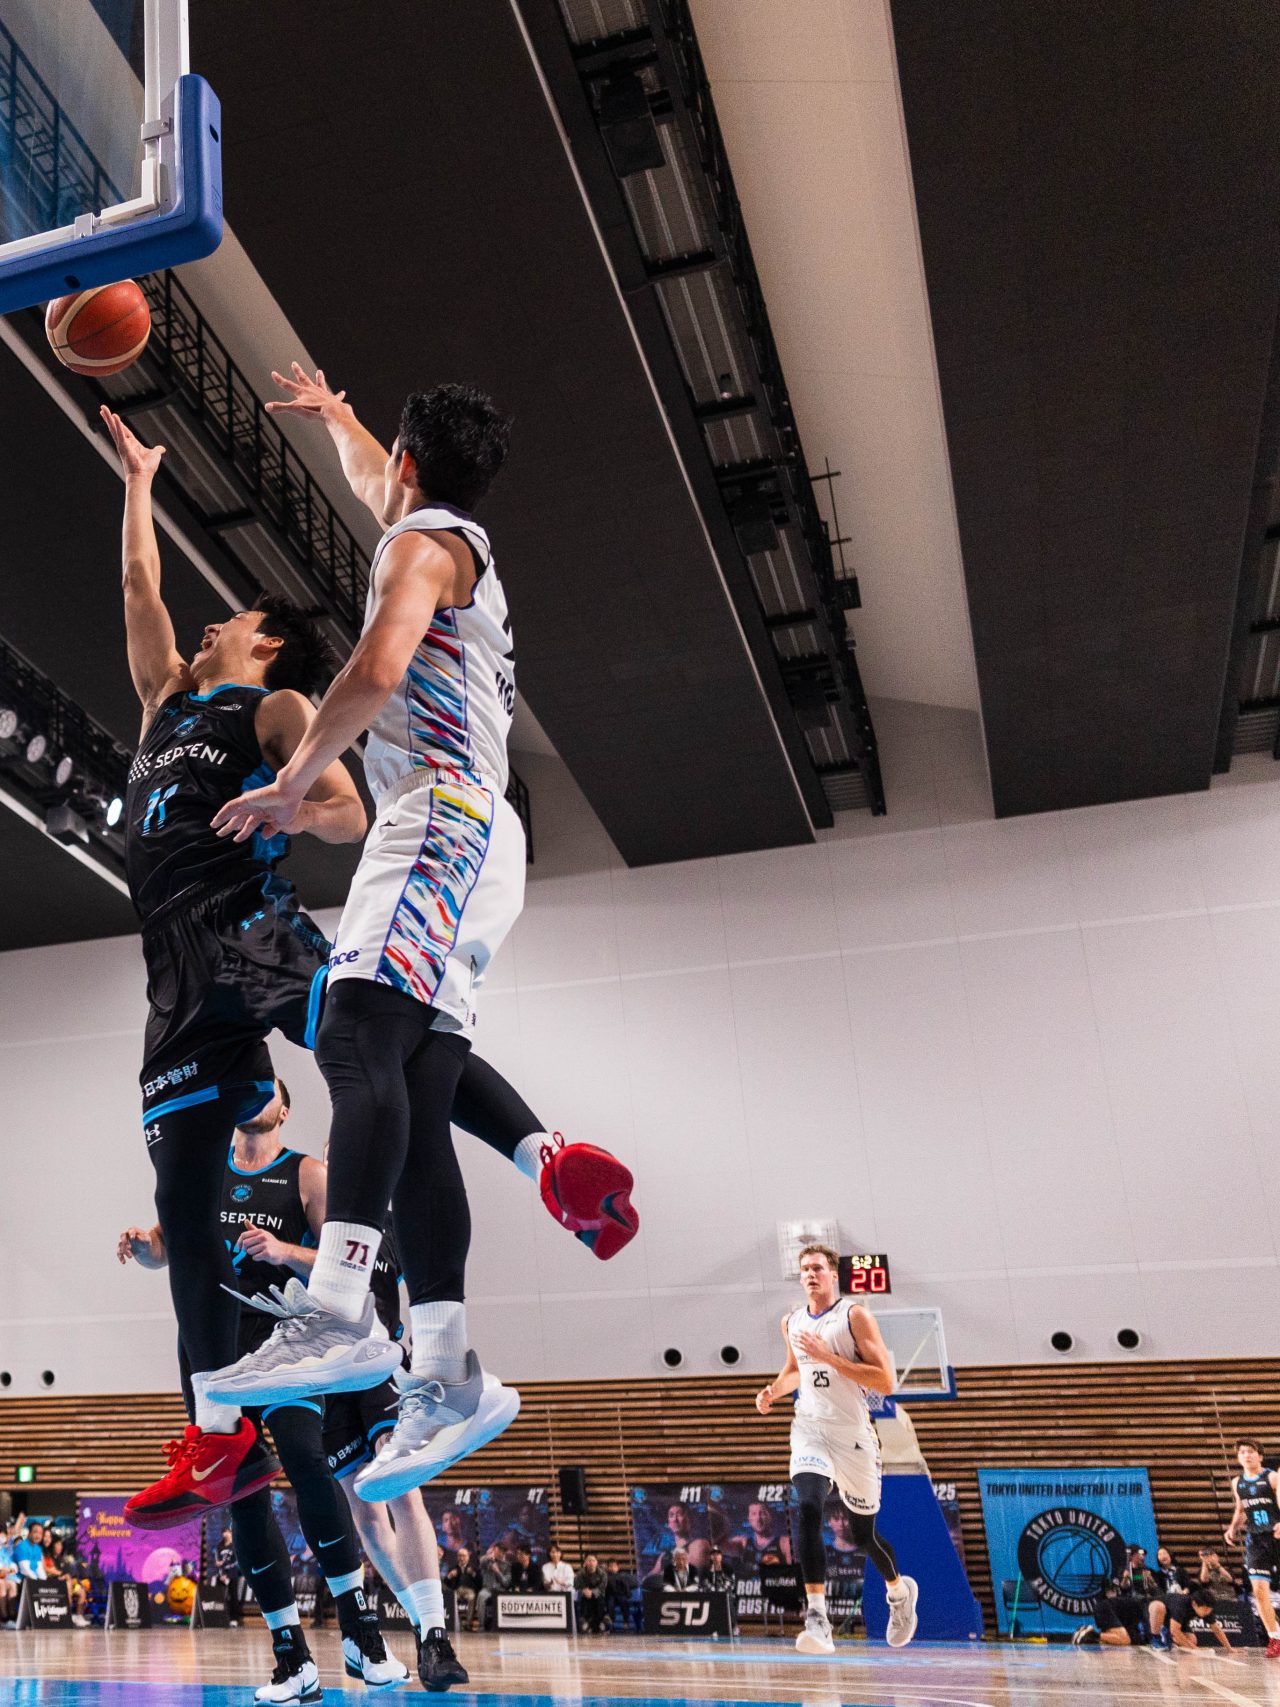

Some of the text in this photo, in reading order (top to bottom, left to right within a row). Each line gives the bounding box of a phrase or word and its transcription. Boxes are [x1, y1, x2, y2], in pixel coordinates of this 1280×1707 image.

[154, 742, 227, 769] SEPTENI
[143, 1061, 199, 1098] 日本管財
[220, 1211, 283, 1230] SEPTENI
[346, 1239, 370, 1266] 71
[851, 1255, 881, 1270] 5:21
[850, 1268, 887, 1293] 20
[812, 1371, 831, 1388] 25
[527, 1487, 544, 1504] #7
[679, 1485, 702, 1503] #11
[757, 1484, 784, 1502] #22
[986, 1482, 1143, 1497] TOKYO UNITED BASKETBALL CLUB
[1026, 1510, 1116, 1543] TOKYO UNITED
[1253, 1509, 1269, 1527] 50
[87, 1524, 132, 1539] Halloween
[659, 1600, 710, 1627] STJ
